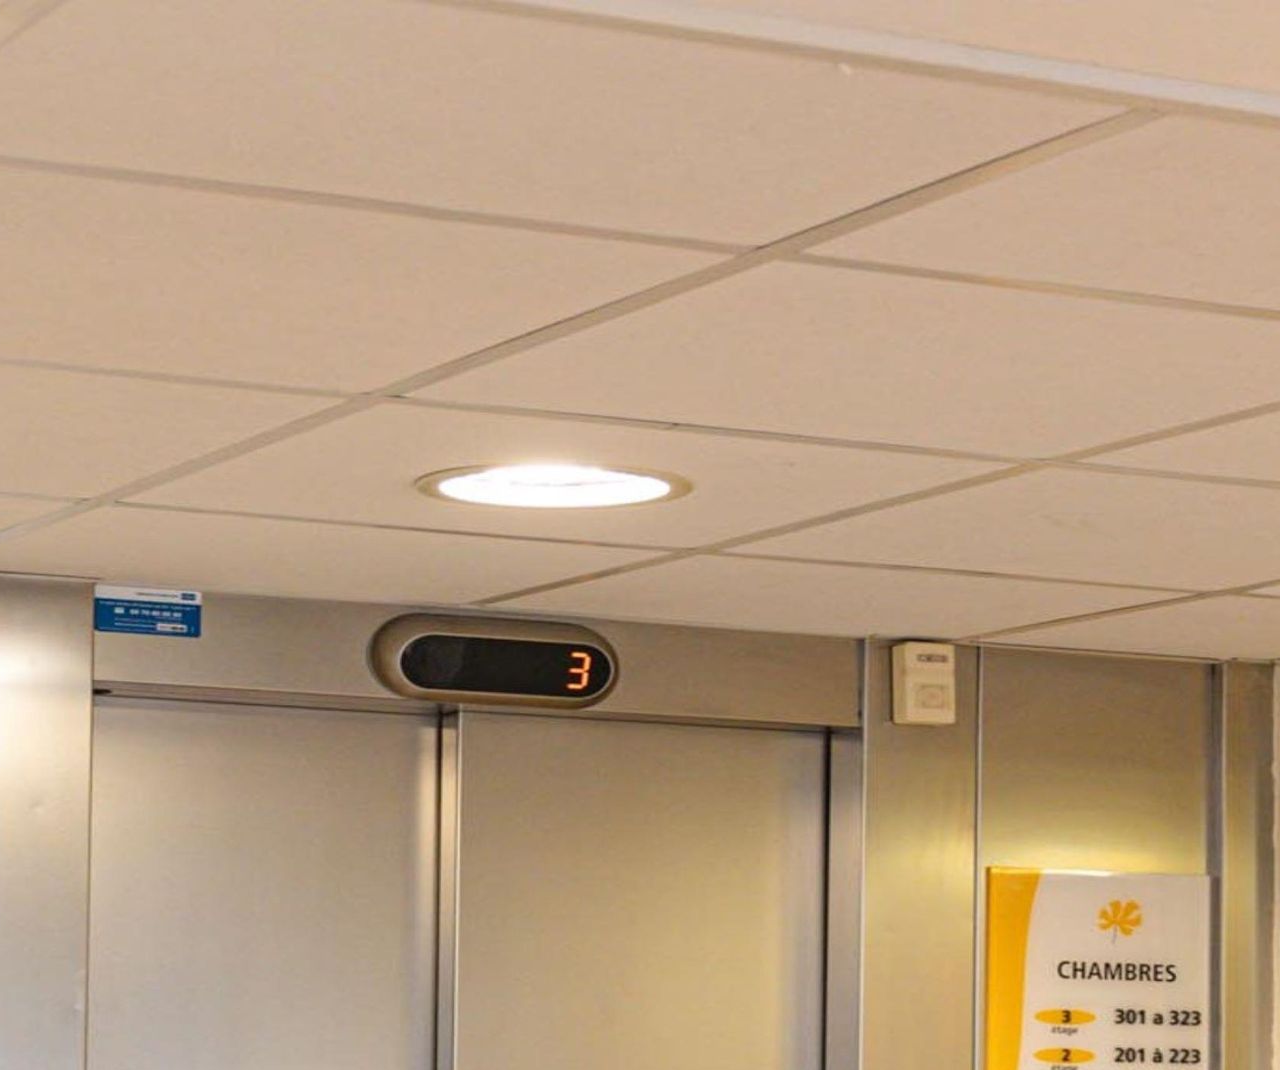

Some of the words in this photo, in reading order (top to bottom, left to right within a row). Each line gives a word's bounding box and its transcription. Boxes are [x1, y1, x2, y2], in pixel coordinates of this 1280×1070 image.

[566, 652, 592, 690] 3
[1056, 960, 1177, 983] CHAMBRES
[1061, 1010, 1072, 1024] 3
[1114, 1008, 1146, 1025] 301
[1169, 1010, 1202, 1026] 323
[1061, 1048, 1072, 1062] 2
[1114, 1047, 1145, 1063] 201
[1152, 1048, 1163, 1063] à
[1169, 1048, 1201, 1064] 223
